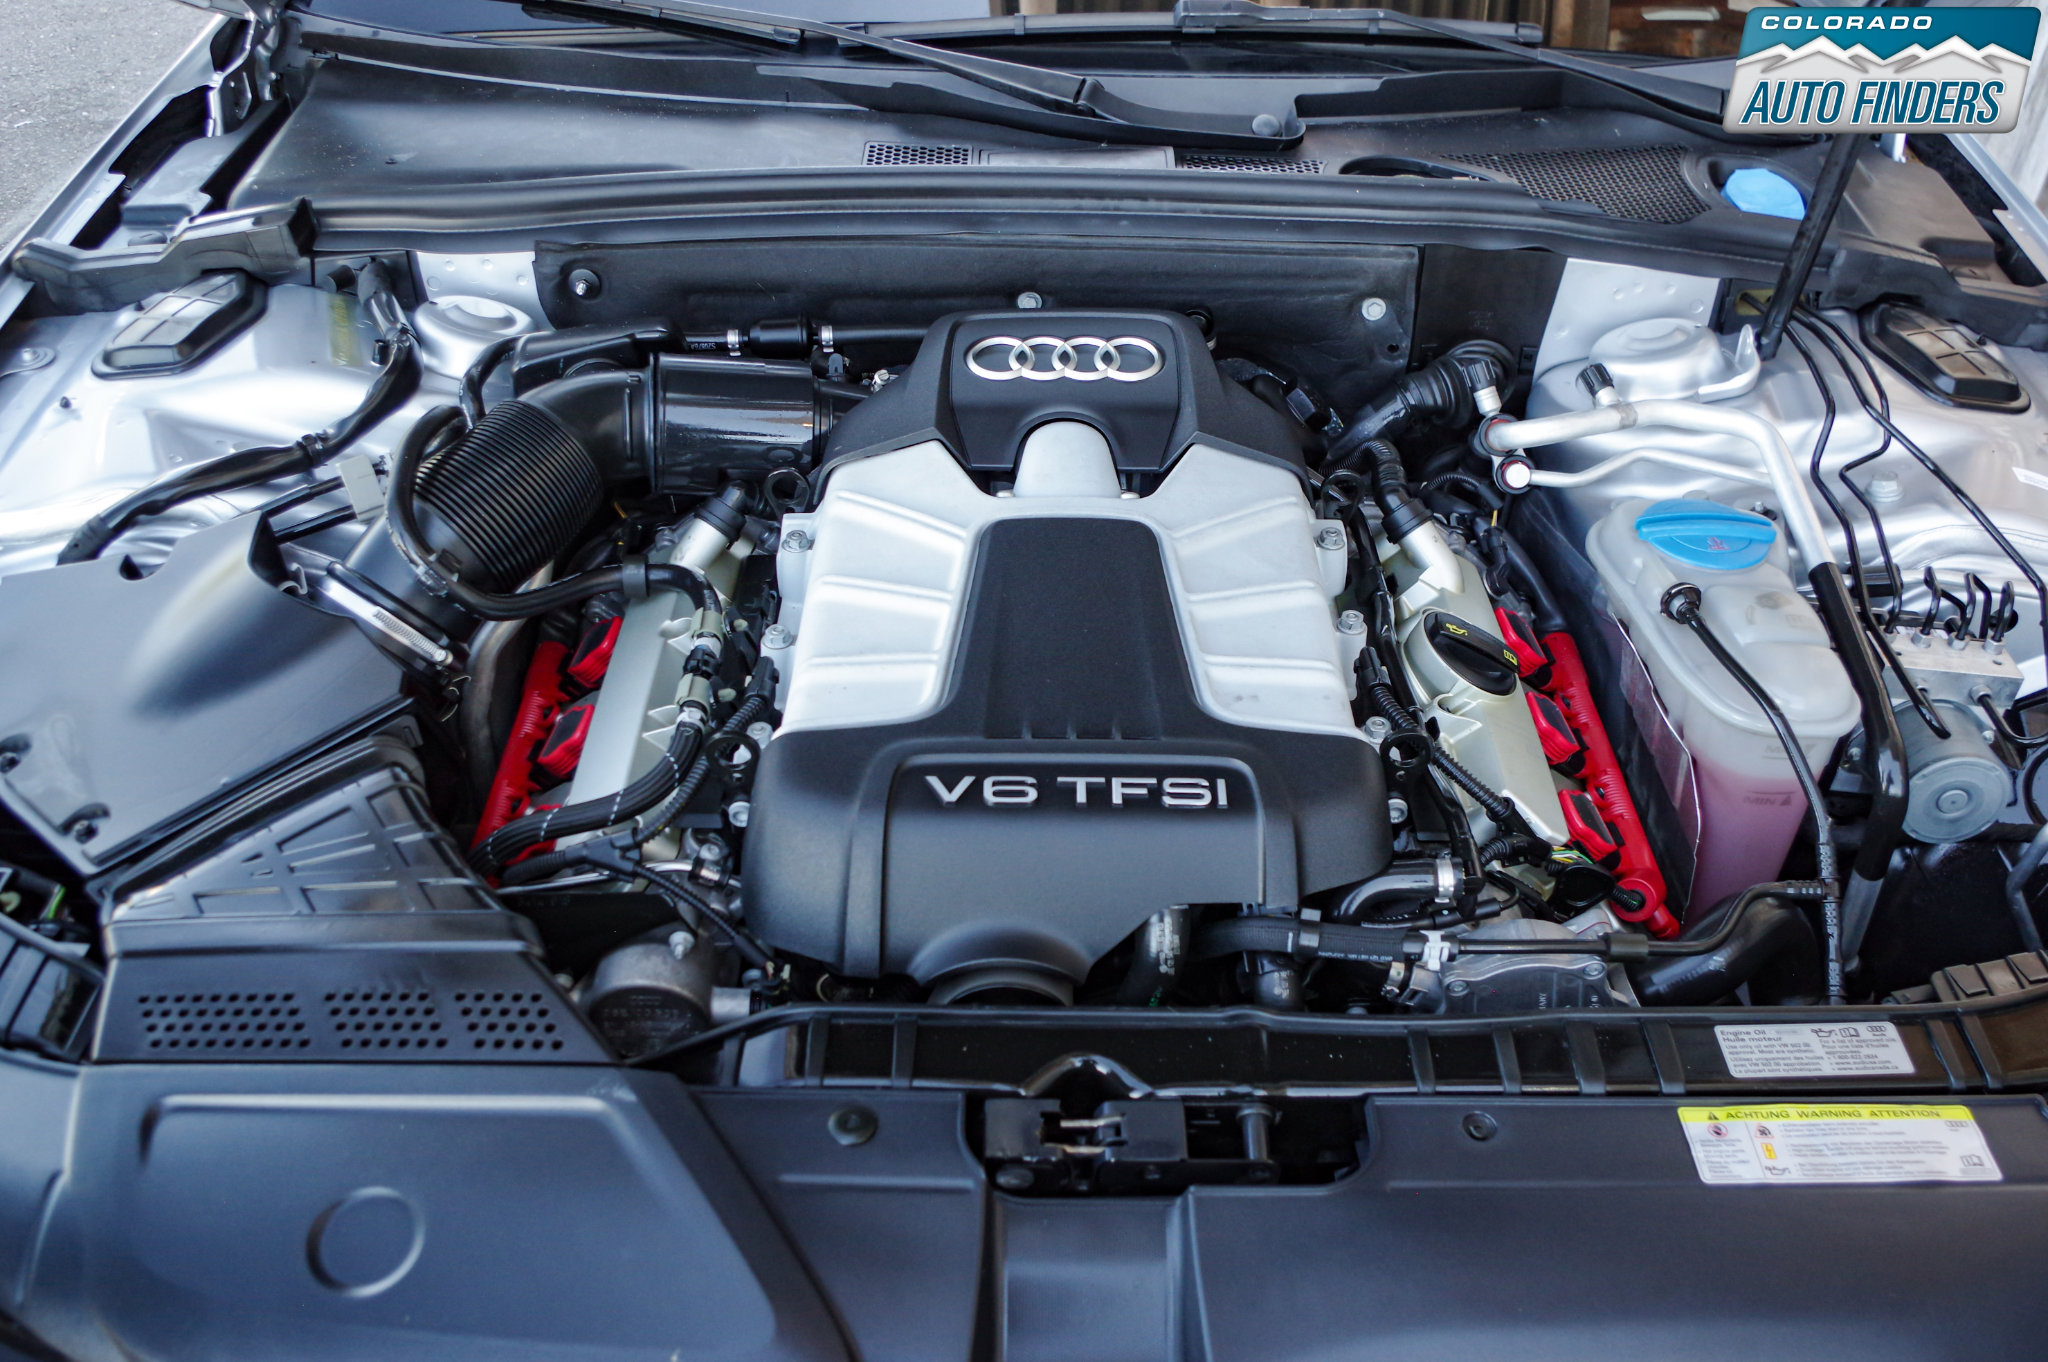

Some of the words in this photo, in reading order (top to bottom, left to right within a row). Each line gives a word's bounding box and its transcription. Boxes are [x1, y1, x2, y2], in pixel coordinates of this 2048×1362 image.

[925, 775, 1039, 807] V6
[1056, 776, 1229, 809] TFSI
[1720, 1029, 1751, 1037] Engine
[1726, 1110, 1791, 1119] ACHTUNG
[1796, 1109, 1862, 1118] WARNING
[1869, 1109, 1942, 1118] ATTENTION
